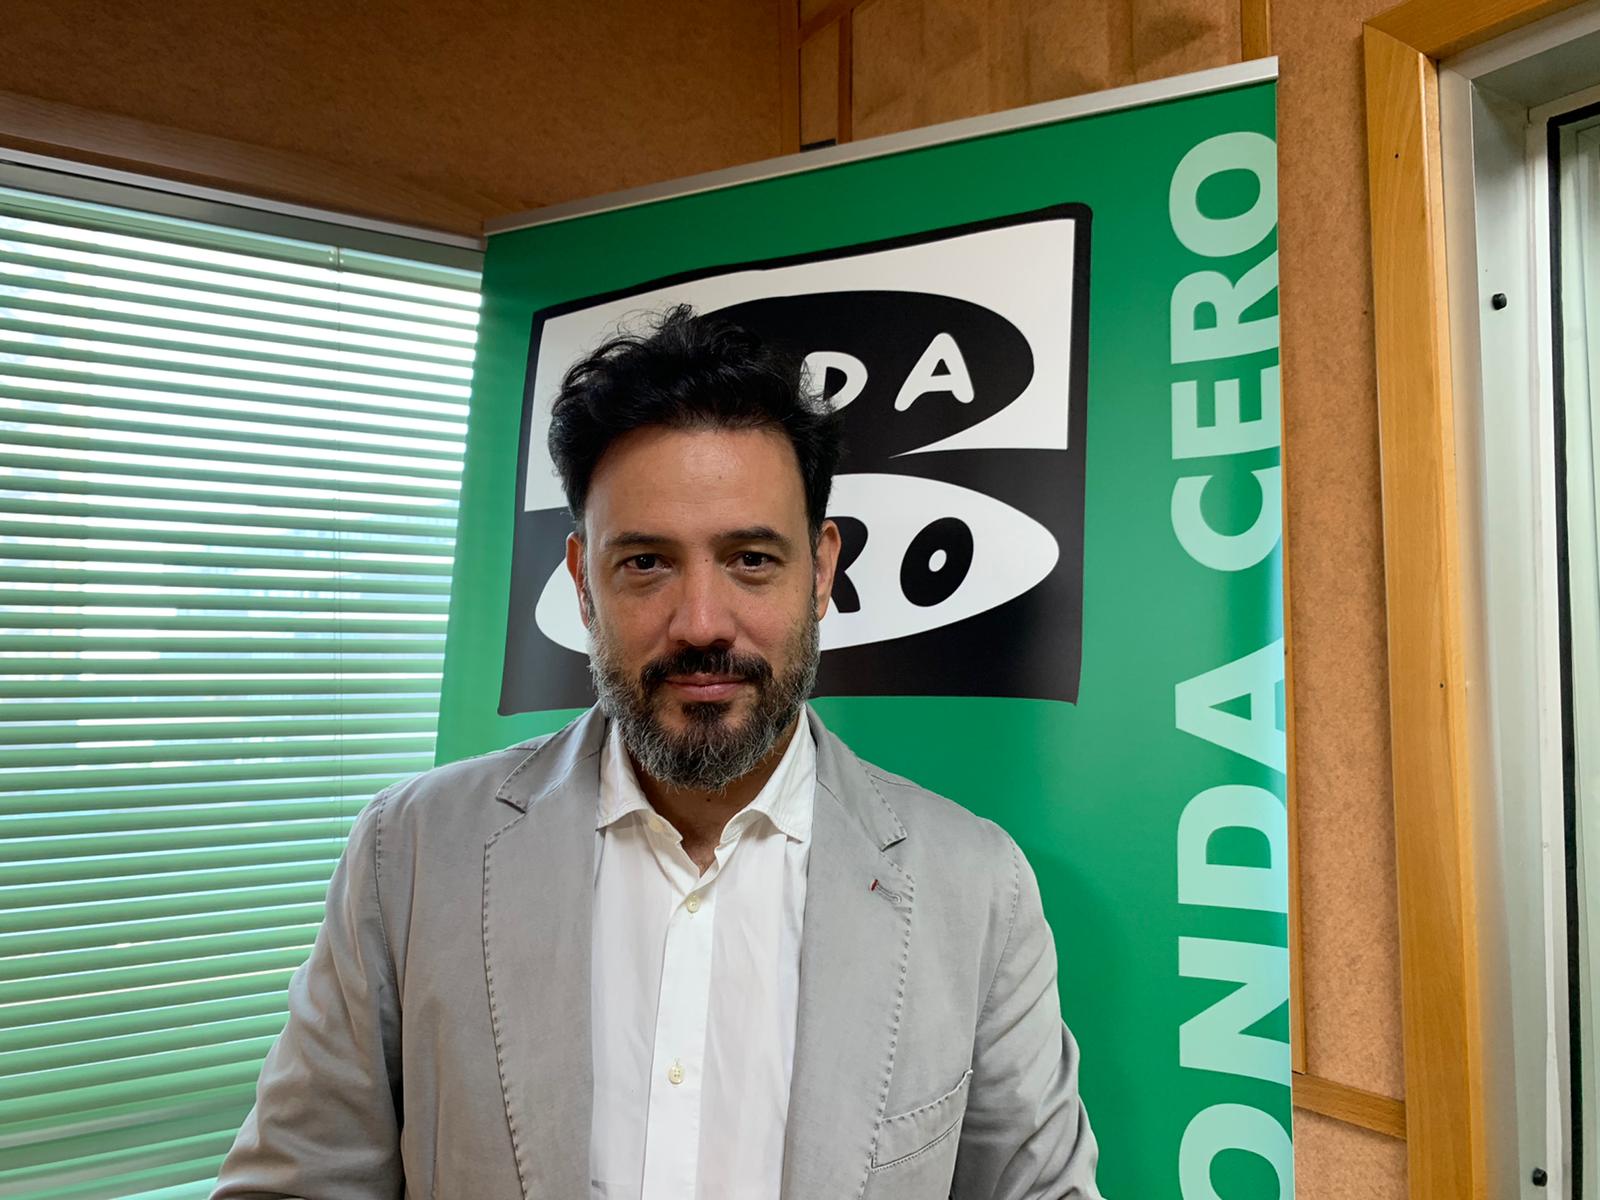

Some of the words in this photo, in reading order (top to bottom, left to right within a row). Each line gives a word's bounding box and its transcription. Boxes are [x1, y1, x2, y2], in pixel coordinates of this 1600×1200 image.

[799, 332, 975, 412] DA
[1169, 131, 1281, 571] CERO
[824, 516, 974, 613] RO
[1175, 637, 1293, 1200] ONDA
